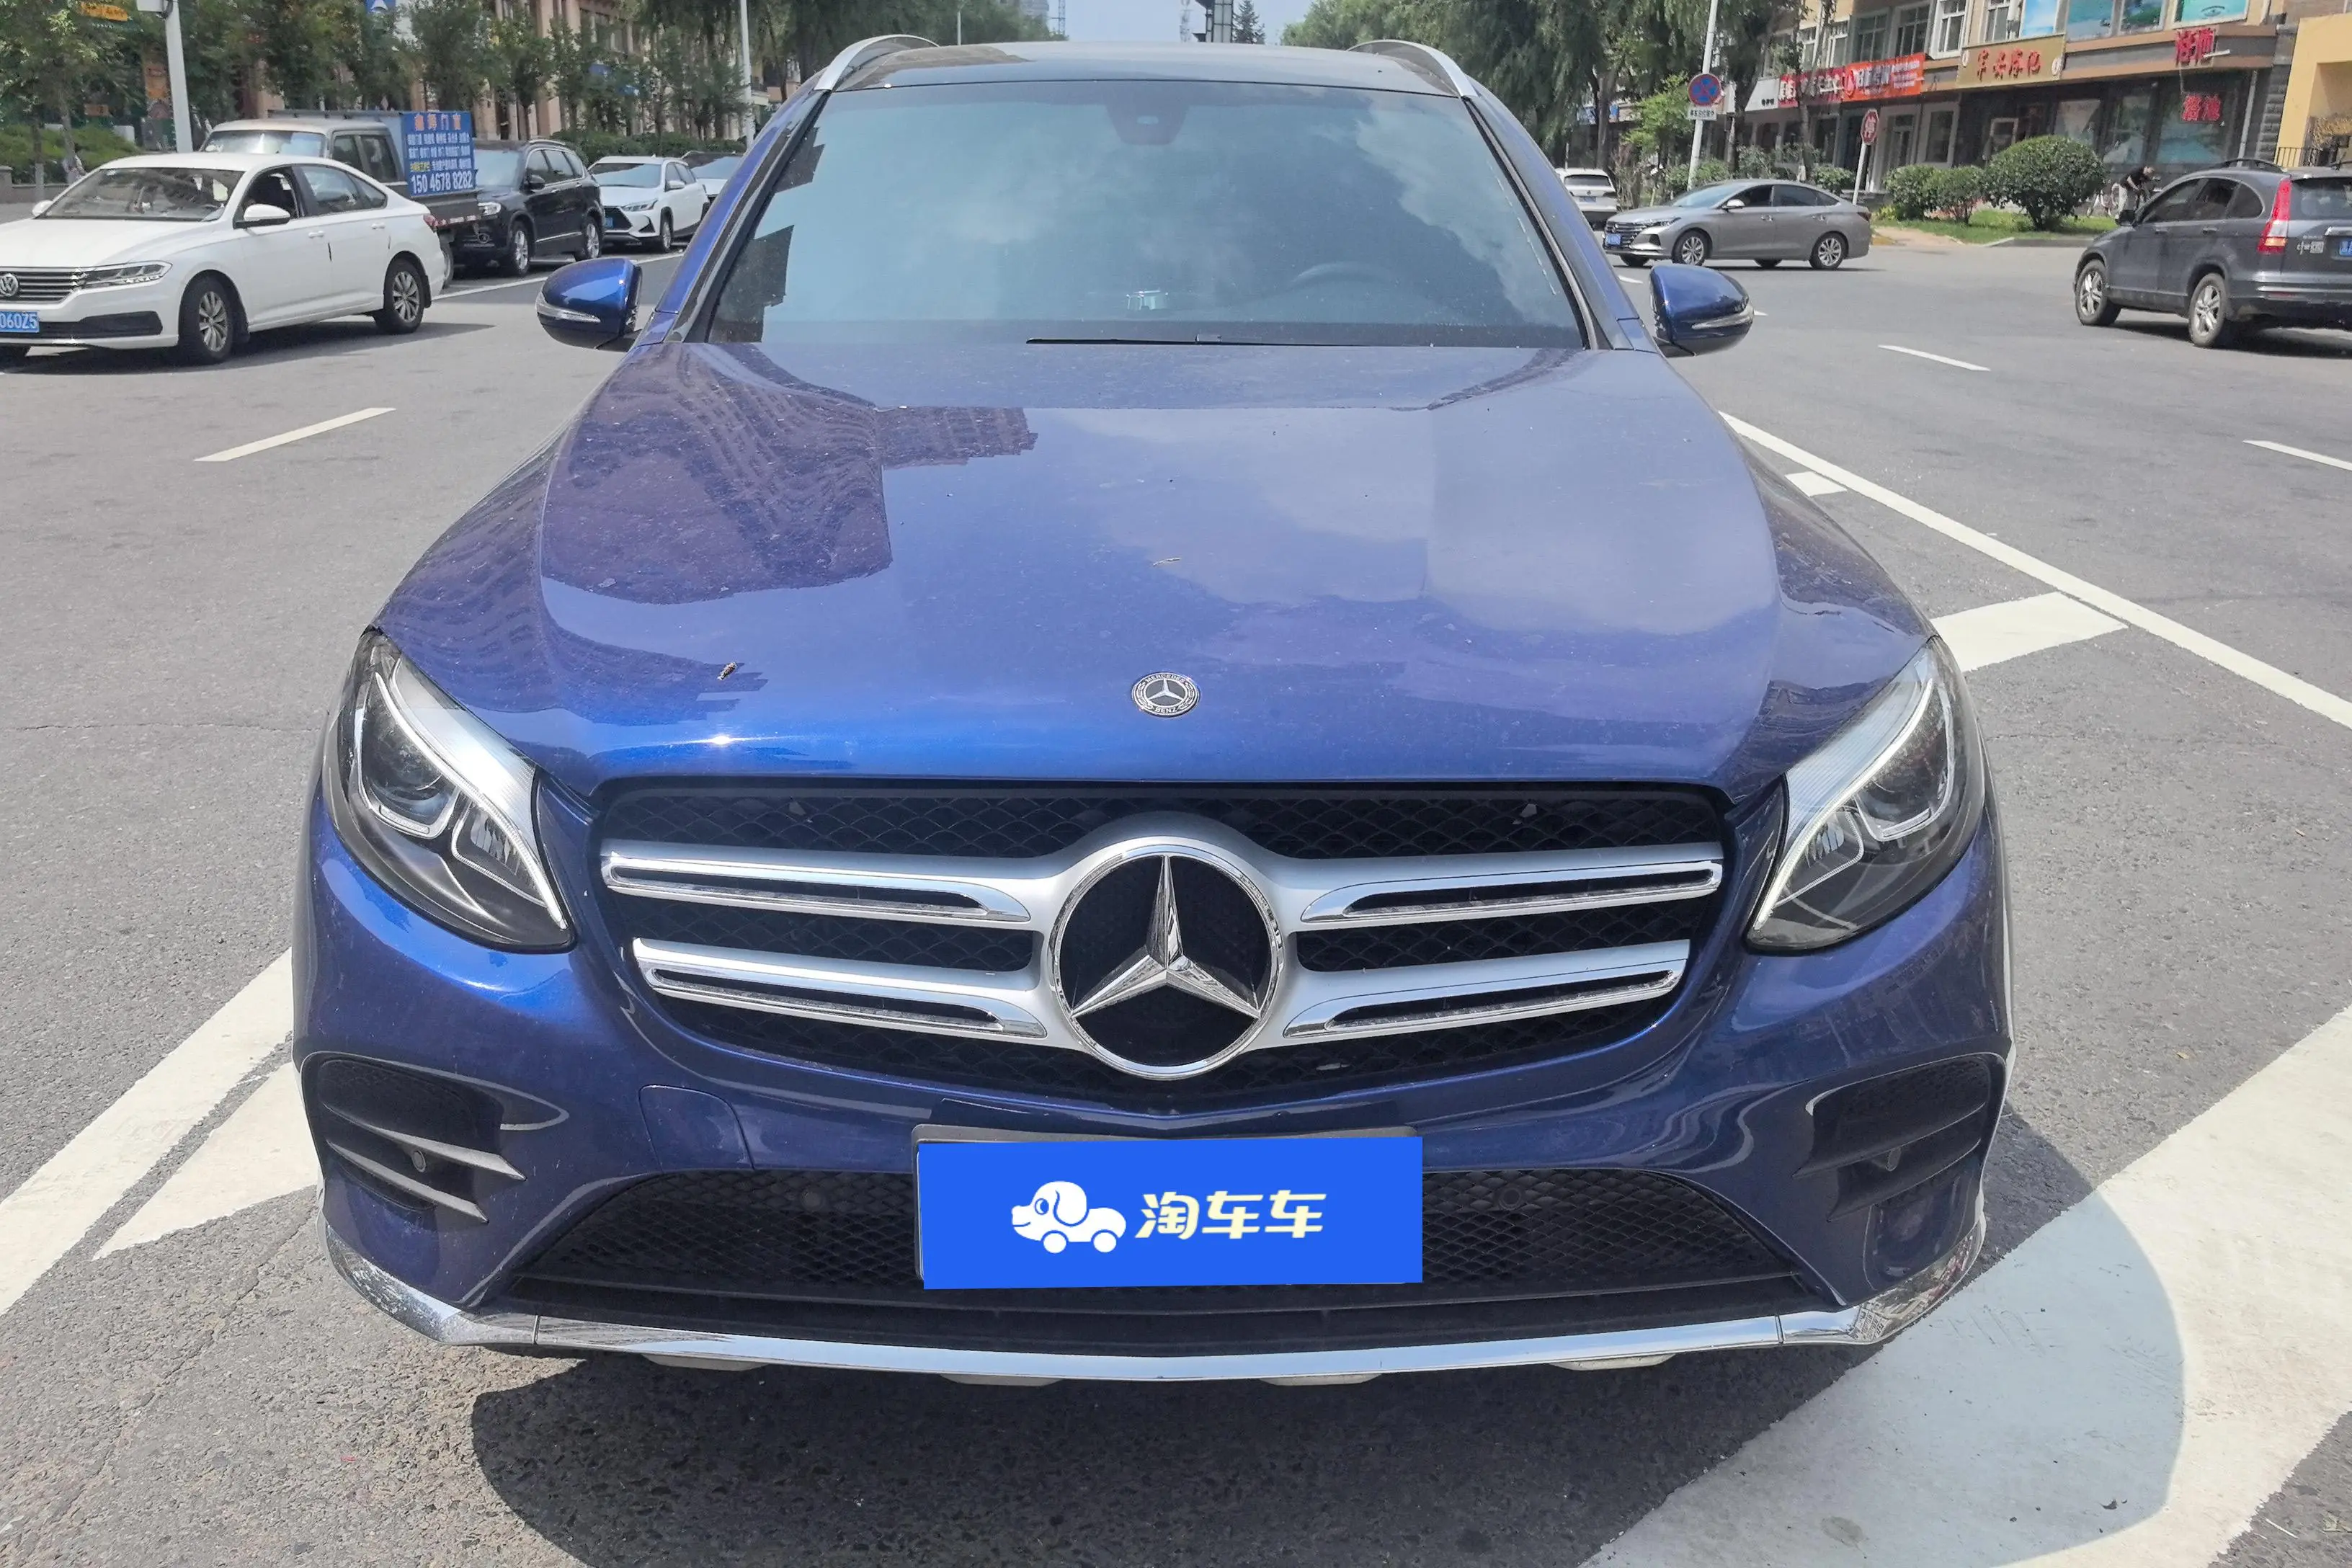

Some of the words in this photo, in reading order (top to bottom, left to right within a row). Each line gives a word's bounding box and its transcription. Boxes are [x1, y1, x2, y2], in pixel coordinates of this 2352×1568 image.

[411, 174, 428, 194] 150
[429, 172, 451, 192] 4678
[453, 170, 473, 190] 8282
[1145, 674, 1186, 682] MERCEDES
